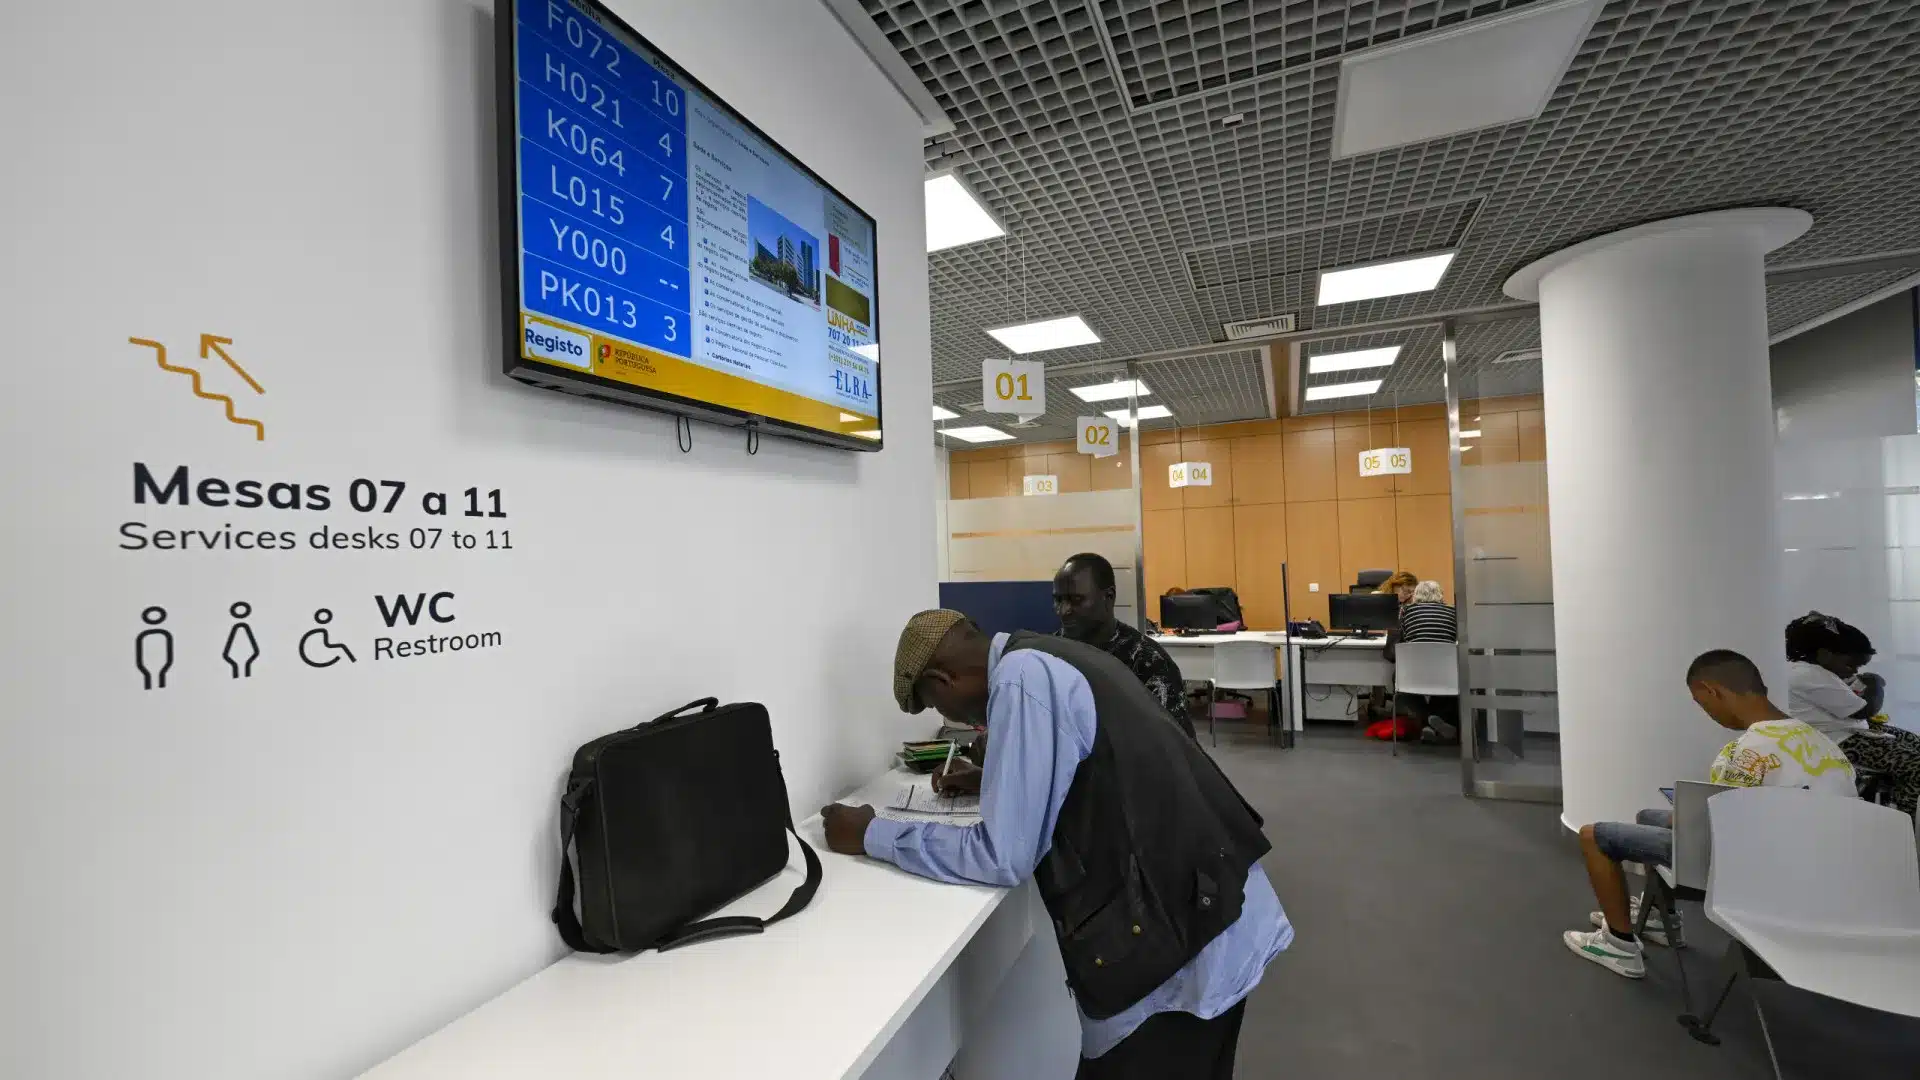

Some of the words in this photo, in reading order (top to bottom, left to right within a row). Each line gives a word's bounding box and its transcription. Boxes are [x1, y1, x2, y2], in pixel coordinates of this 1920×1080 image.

[547, 1, 621, 78] F072
[652, 79, 679, 116] 10
[545, 52, 624, 128] H021
[658, 132, 673, 157] 4
[548, 108, 625, 176] K064
[660, 174, 673, 201] 7
[551, 164, 624, 225] L015
[660, 224, 675, 250] 4
[549, 217, 626, 275] Y000
[541, 270, 637, 329] PK013
[663, 315, 677, 342] 3
[525, 328, 583, 357] Registo
[828, 326, 840, 340] 707
[842, 333, 850, 346] 20
[834, 368, 870, 399] ELRA
[995, 372, 1032, 400] 01
[1085, 425, 1110, 445] 02
[1172, 468, 1185, 481] 04
[1192, 467, 1207, 480] 04
[1364, 456, 1381, 469] 05
[1391, 454, 1407, 467] 05
[133, 462, 331, 511] Mesas
[348, 478, 406, 514] 07
[422, 490, 447, 516] a
[463, 487, 507, 518] 11
[1037, 480, 1053, 492] 03
[118, 521, 296, 550] Services
[309, 525, 400, 550] desks
[409, 528, 443, 549] 07
[451, 531, 477, 549] to
[485, 530, 513, 549] 11
[374, 591, 456, 628] WC
[374, 630, 502, 660] Restroom
